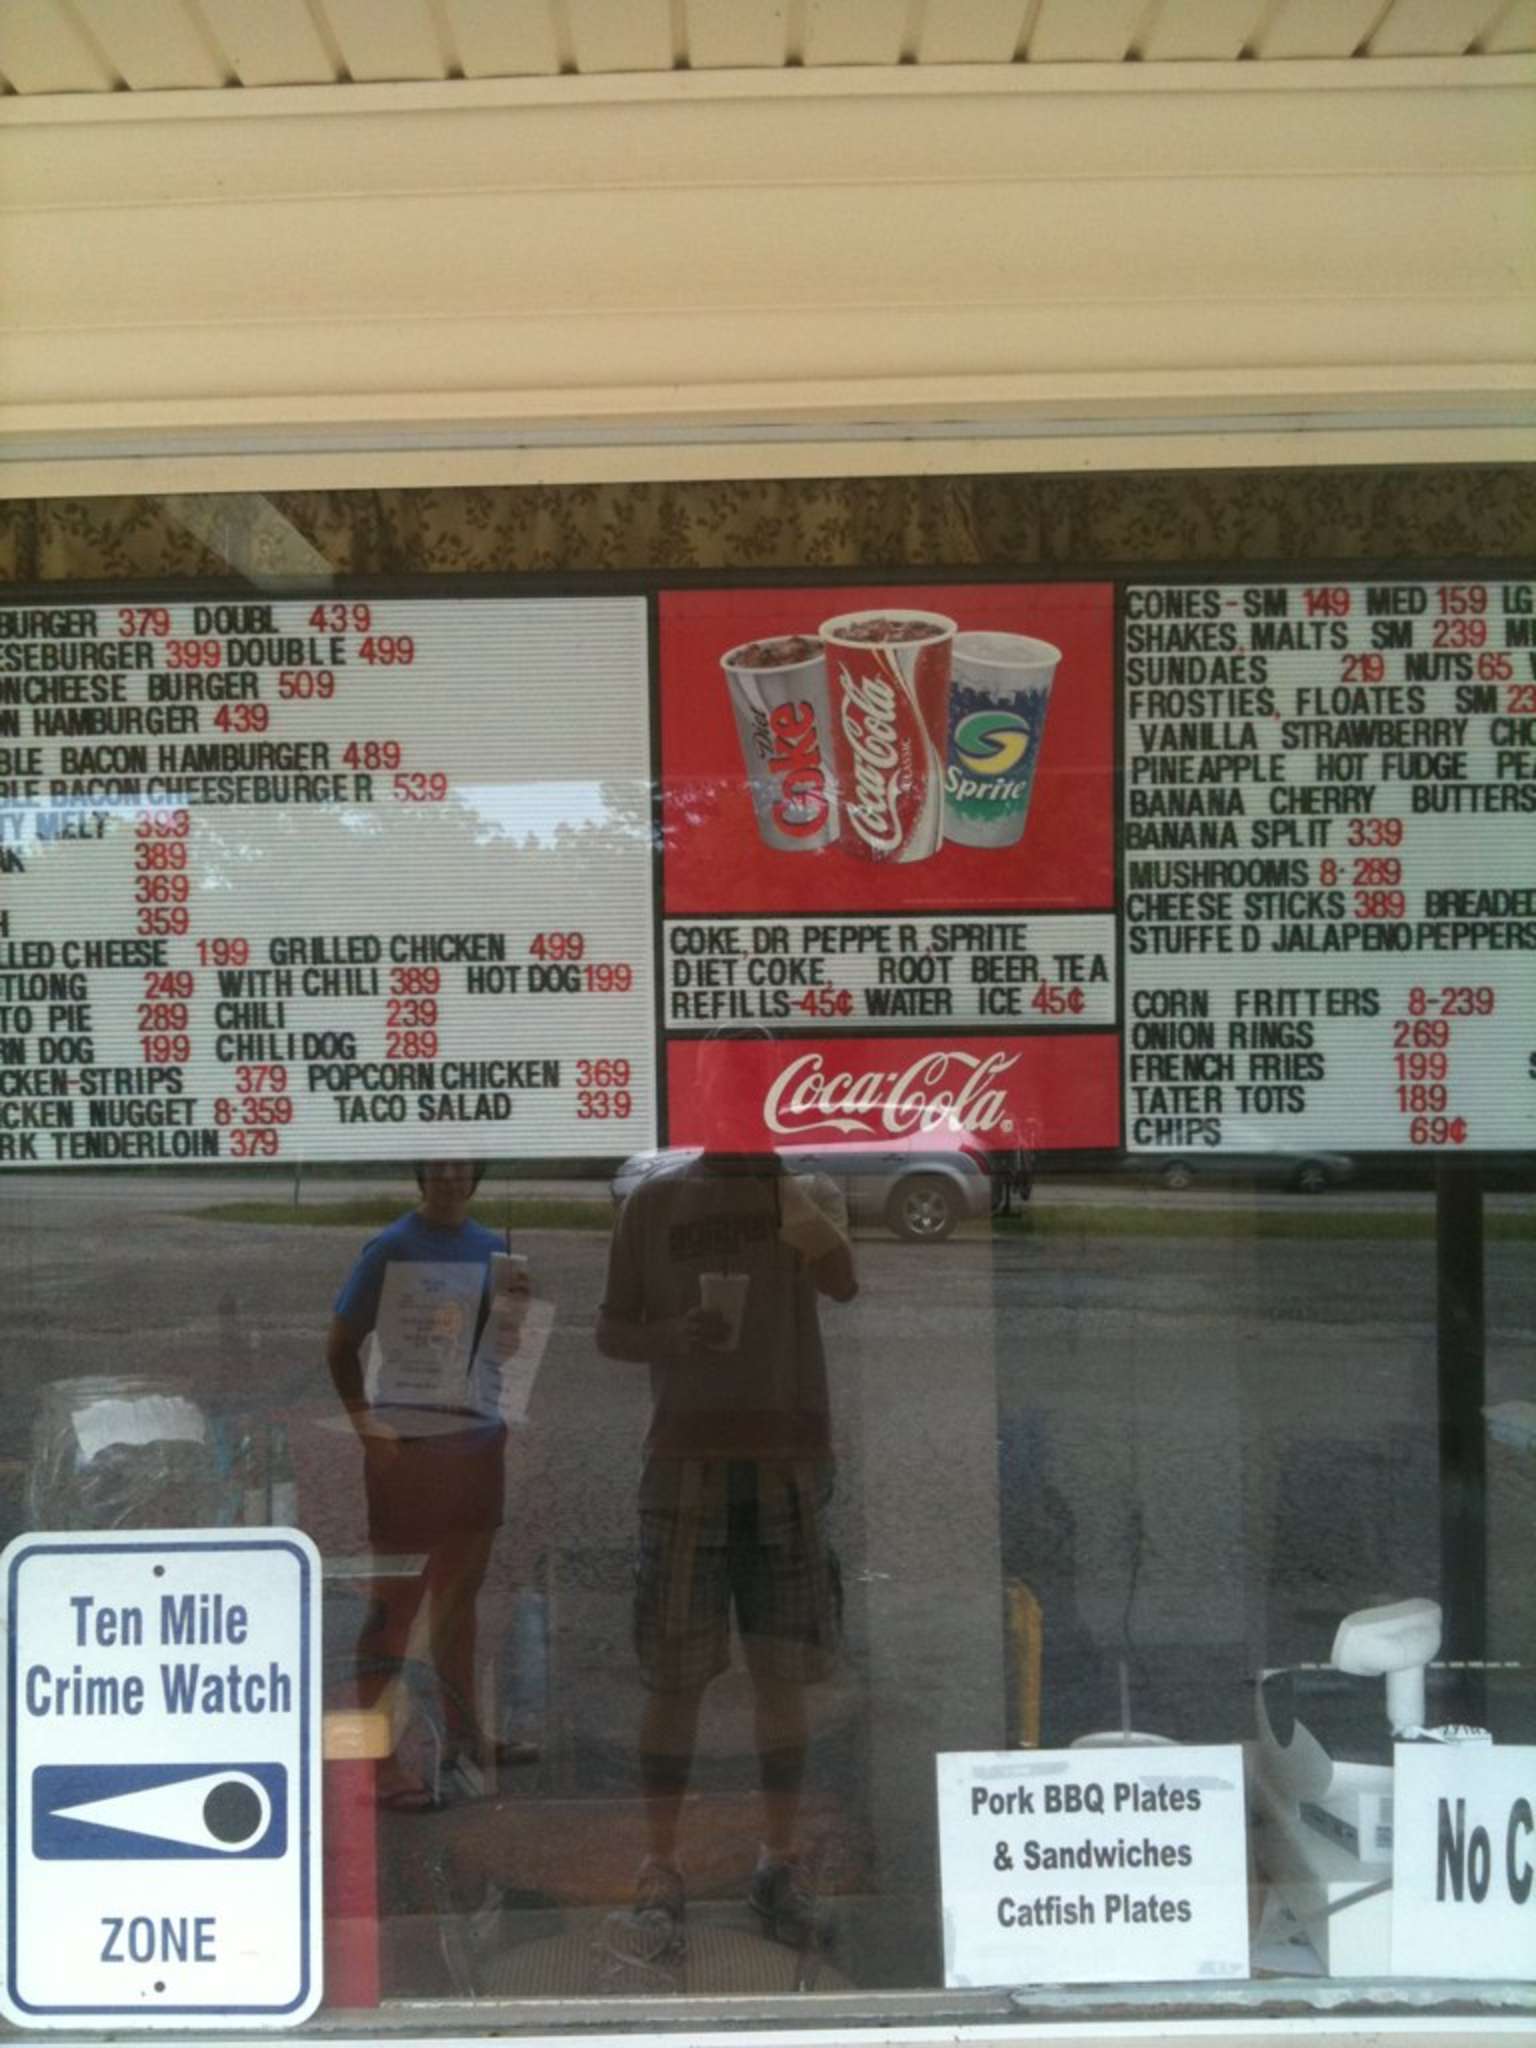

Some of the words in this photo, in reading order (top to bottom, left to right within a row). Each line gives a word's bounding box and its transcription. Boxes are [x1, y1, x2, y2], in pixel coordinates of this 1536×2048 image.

[1303, 586, 1350, 617] 149
[1366, 585, 1428, 616] MED
[1439, 585, 1487, 615] 159
[1502, 585, 1533, 615] LG
[0, 608, 97, 639] BURGER
[118, 607, 170, 638] 379
[193, 605, 279, 636] DOUBL
[309, 603, 372, 633] 439
[1252, 620, 1349, 651] MALTS
[1371, 619, 1413, 650] SM
[1432, 618, 1487, 649] 239
[0, 639, 154, 672] SEBURGER
[165, 639, 221, 669] 399
[227, 636, 347, 667] DOUBLE
[358, 635, 415, 666] 499
[1127, 655, 1268, 687] SUNDAES
[1341, 652, 1385, 683] 219
[1404, 651, 1473, 682] NUTS
[1477, 651, 1514, 681] 65
[0, 673, 127, 705] NCHEESE
[147, 672, 259, 702] BURGER
[278, 670, 335, 700] 509
[1296, 685, 1426, 716] FLOATES
[1455, 684, 1498, 715] SM
[33, 704, 199, 737] HAMBURGER
[213, 703, 269, 733] 439
[1139, 721, 1259, 753] VANILLA
[1280, 718, 1469, 750] STRAWBERRY
[61, 746, 147, 775] BACON
[158, 741, 330, 774] HAMBURGER
[342, 740, 401, 770] 489
[769, 701, 830, 840] Coke
[1131, 753, 1286, 785] PINEAPPLE
[1316, 752, 1369, 782] HOT
[1382, 751, 1468, 781] FUDGE
[1496, 751, 1536, 780] PE
[51, 778, 140, 808] BACON
[147, 774, 373, 807] CHEESEBURGER
[394, 772, 447, 803] 539
[943, 765, 1027, 802] Sprite
[1129, 787, 1245, 818] BANANA
[1269, 785, 1376, 815] CHERRY
[1125, 821, 1239, 850] BANANA
[1251, 818, 1333, 849] SPLIT
[1347, 817, 1404, 848] 339
[134, 842, 187, 871] 389
[1128, 858, 1310, 889] MUSHROOMS
[134, 874, 189, 903] 369
[1127, 891, 1233, 922] CHEESE
[1243, 890, 1346, 920] STICKS
[1353, 889, 1405, 919] 389
[136, 907, 190, 936] 359
[753, 925, 790, 954] DR
[931, 923, 1027, 952] SPRITE
[1129, 924, 1261, 955] STUFFED
[1416, 920, 1536, 950] PEPPERS
[62, 939, 168, 970] CHEESE
[196, 937, 250, 967] 199
[269, 935, 382, 967] GRILLED
[390, 933, 506, 963] CHICKEN
[529, 932, 585, 961] 499
[143, 970, 194, 1000] 249
[217, 968, 293, 998] WITH
[302, 967, 378, 997] CHILI
[389, 967, 441, 996] 389
[467, 965, 520, 994] HOT
[528, 964, 581, 993] DOG
[584, 963, 633, 992] 199
[673, 957, 739, 987] DIET
[878, 955, 953, 984] ROOT
[1053, 953, 1110, 983] TEA
[49, 1004, 93, 1033] PIE
[137, 1003, 189, 1032] 289
[214, 1001, 286, 1030] CHILI
[386, 999, 438, 1028] 239
[864, 987, 953, 1017] WATER
[978, 986, 1022, 1015] ICE
[1132, 988, 1209, 1018] CORN
[1235, 987, 1381, 1017] FRITTERS
[38, 1036, 95, 1065] DOG
[140, 1034, 191, 1064] 199
[385, 1030, 438, 1059] 289
[1131, 1021, 1215, 1050] ONION
[1228, 1020, 1315, 1050] RINGS
[1393, 1019, 1450, 1049] 269
[235, 1065, 288, 1094] 379
[308, 1062, 435, 1093] POPCORN
[441, 1060, 559, 1091] CHICKEN
[576, 1058, 631, 1088] 369
[1130, 1053, 1235, 1083] FRENCH
[1248, 1052, 1326, 1082] FRIES
[1393, 1051, 1448, 1081] 199
[90, 1098, 197, 1128] NUGGET
[334, 1094, 407, 1124] TACO
[417, 1092, 512, 1122] SALAD
[576, 1090, 632, 1120] 339
[1131, 1086, 1223, 1115] TATER
[1235, 1084, 1306, 1114] TOTS
[1395, 1083, 1448, 1113] 189
[51, 1129, 220, 1159] TENDERLOIN
[229, 1128, 279, 1158] 379
[1133, 1117, 1222, 1147] CHIPS
[70, 1595, 143, 1647] Ten
[160, 1594, 248, 1646] Mile
[26, 1664, 145, 1717] Crime
[161, 1661, 292, 1714] Watch
[971, 1785, 1035, 1816] Pork
[1044, 1783, 1105, 1815] BBQ
[1113, 1782, 1201, 1813] Plates
[993, 1840, 1014, 1871] &
[1023, 1837, 1193, 1871] Sandwiches
[1436, 1797, 1492, 1905] No
[997, 1895, 1096, 1928] Catfish
[1104, 1893, 1192, 1924] Plates
[100, 1916, 217, 1963] ZONE
